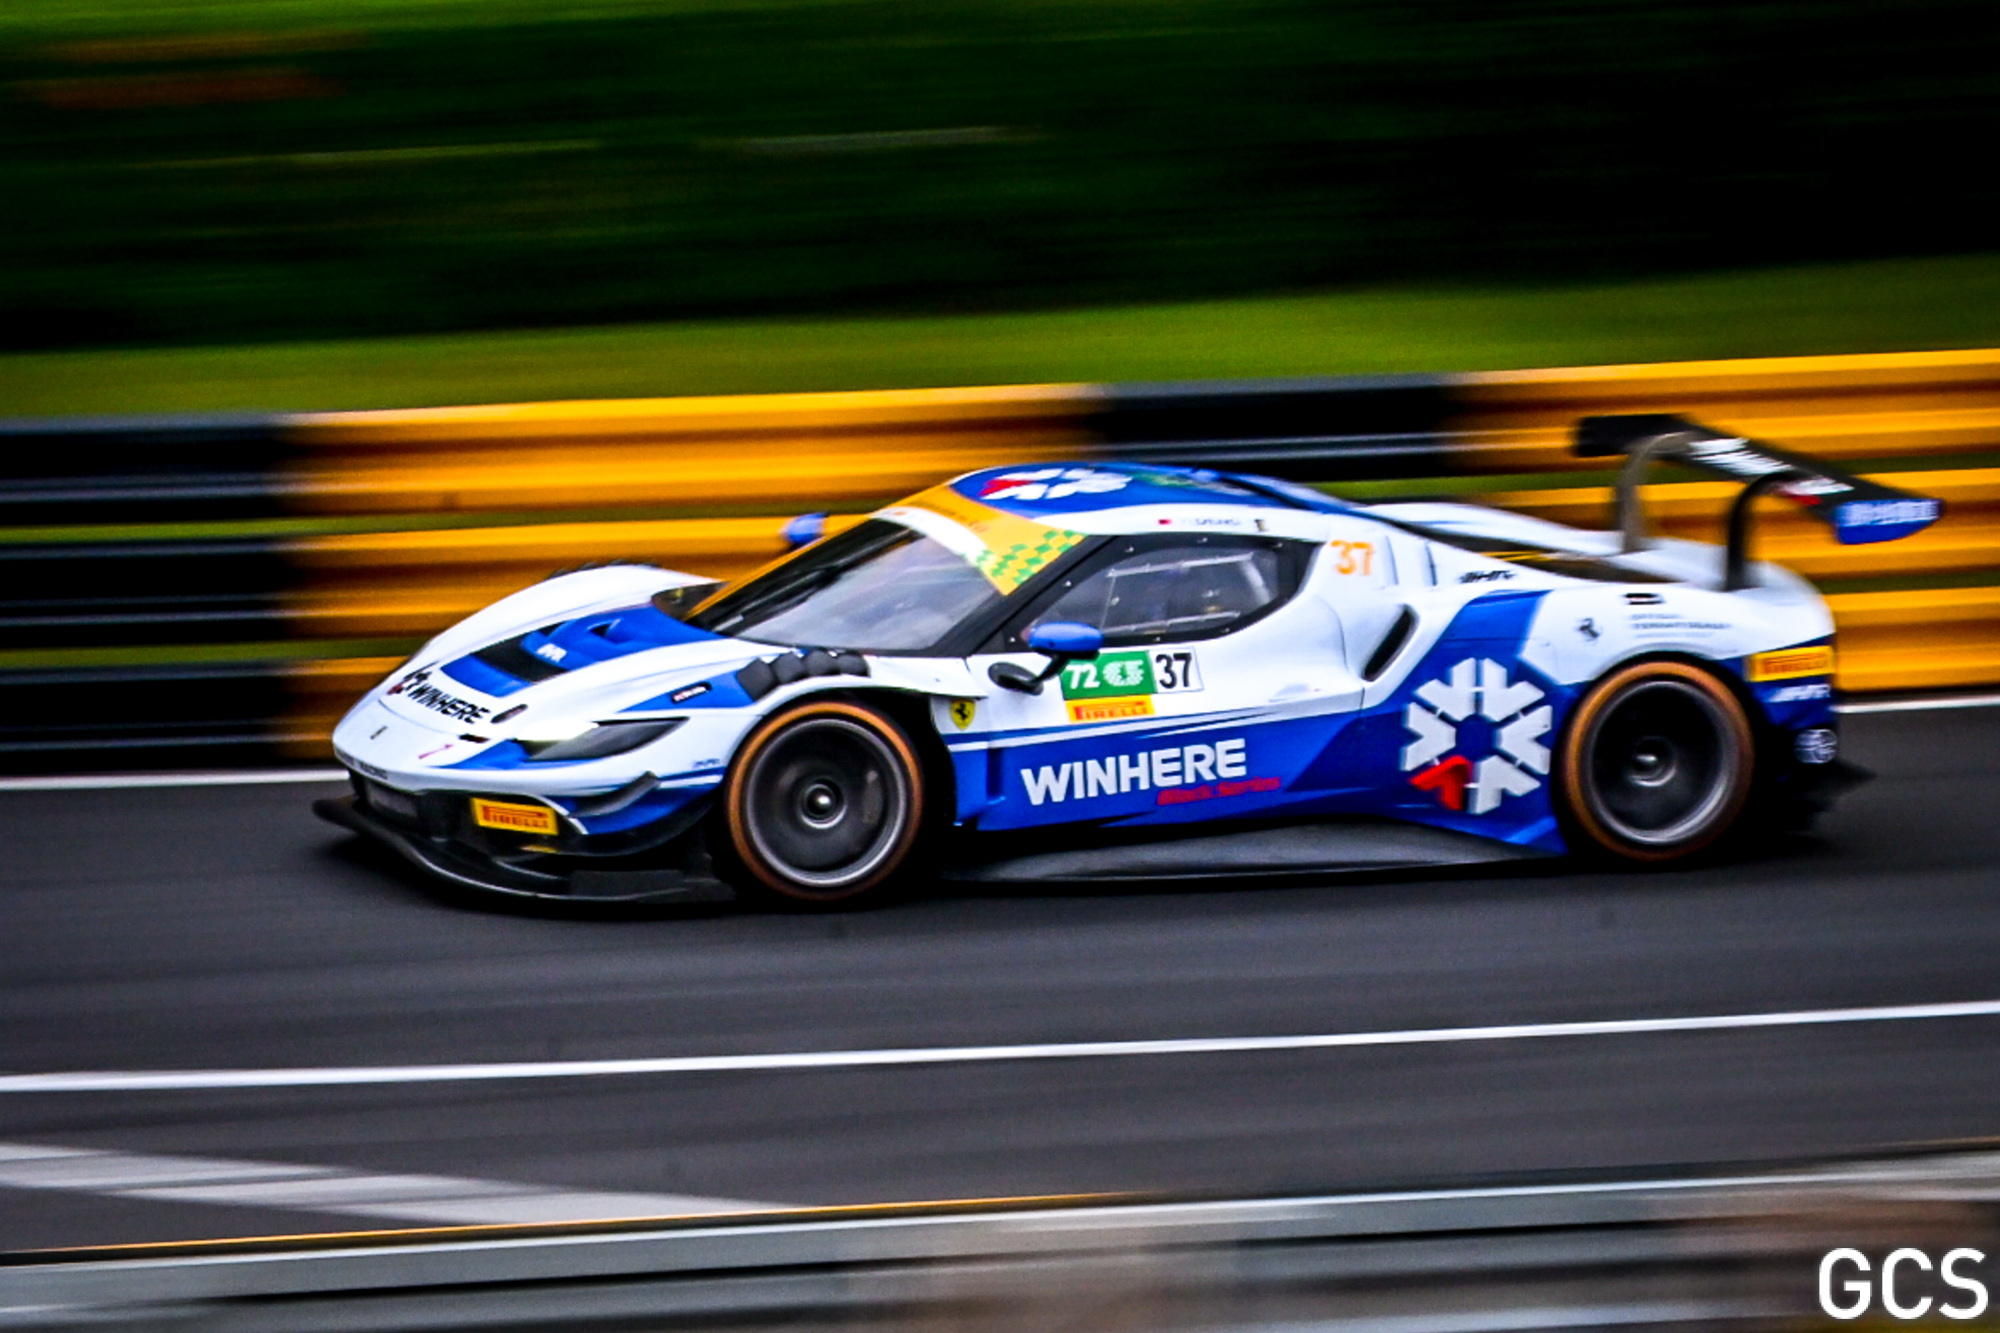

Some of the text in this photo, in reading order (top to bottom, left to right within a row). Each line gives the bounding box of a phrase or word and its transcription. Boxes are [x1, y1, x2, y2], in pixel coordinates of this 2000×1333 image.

[1331, 540, 1373, 576] 37
[1066, 664, 1101, 689] 72
[1156, 653, 1192, 689] 37
[408, 684, 491, 724] WINHERE
[1074, 701, 1147, 720] PIRELLI
[1020, 738, 1247, 805] WINHERE
[482, 805, 549, 829] PIRELLI
